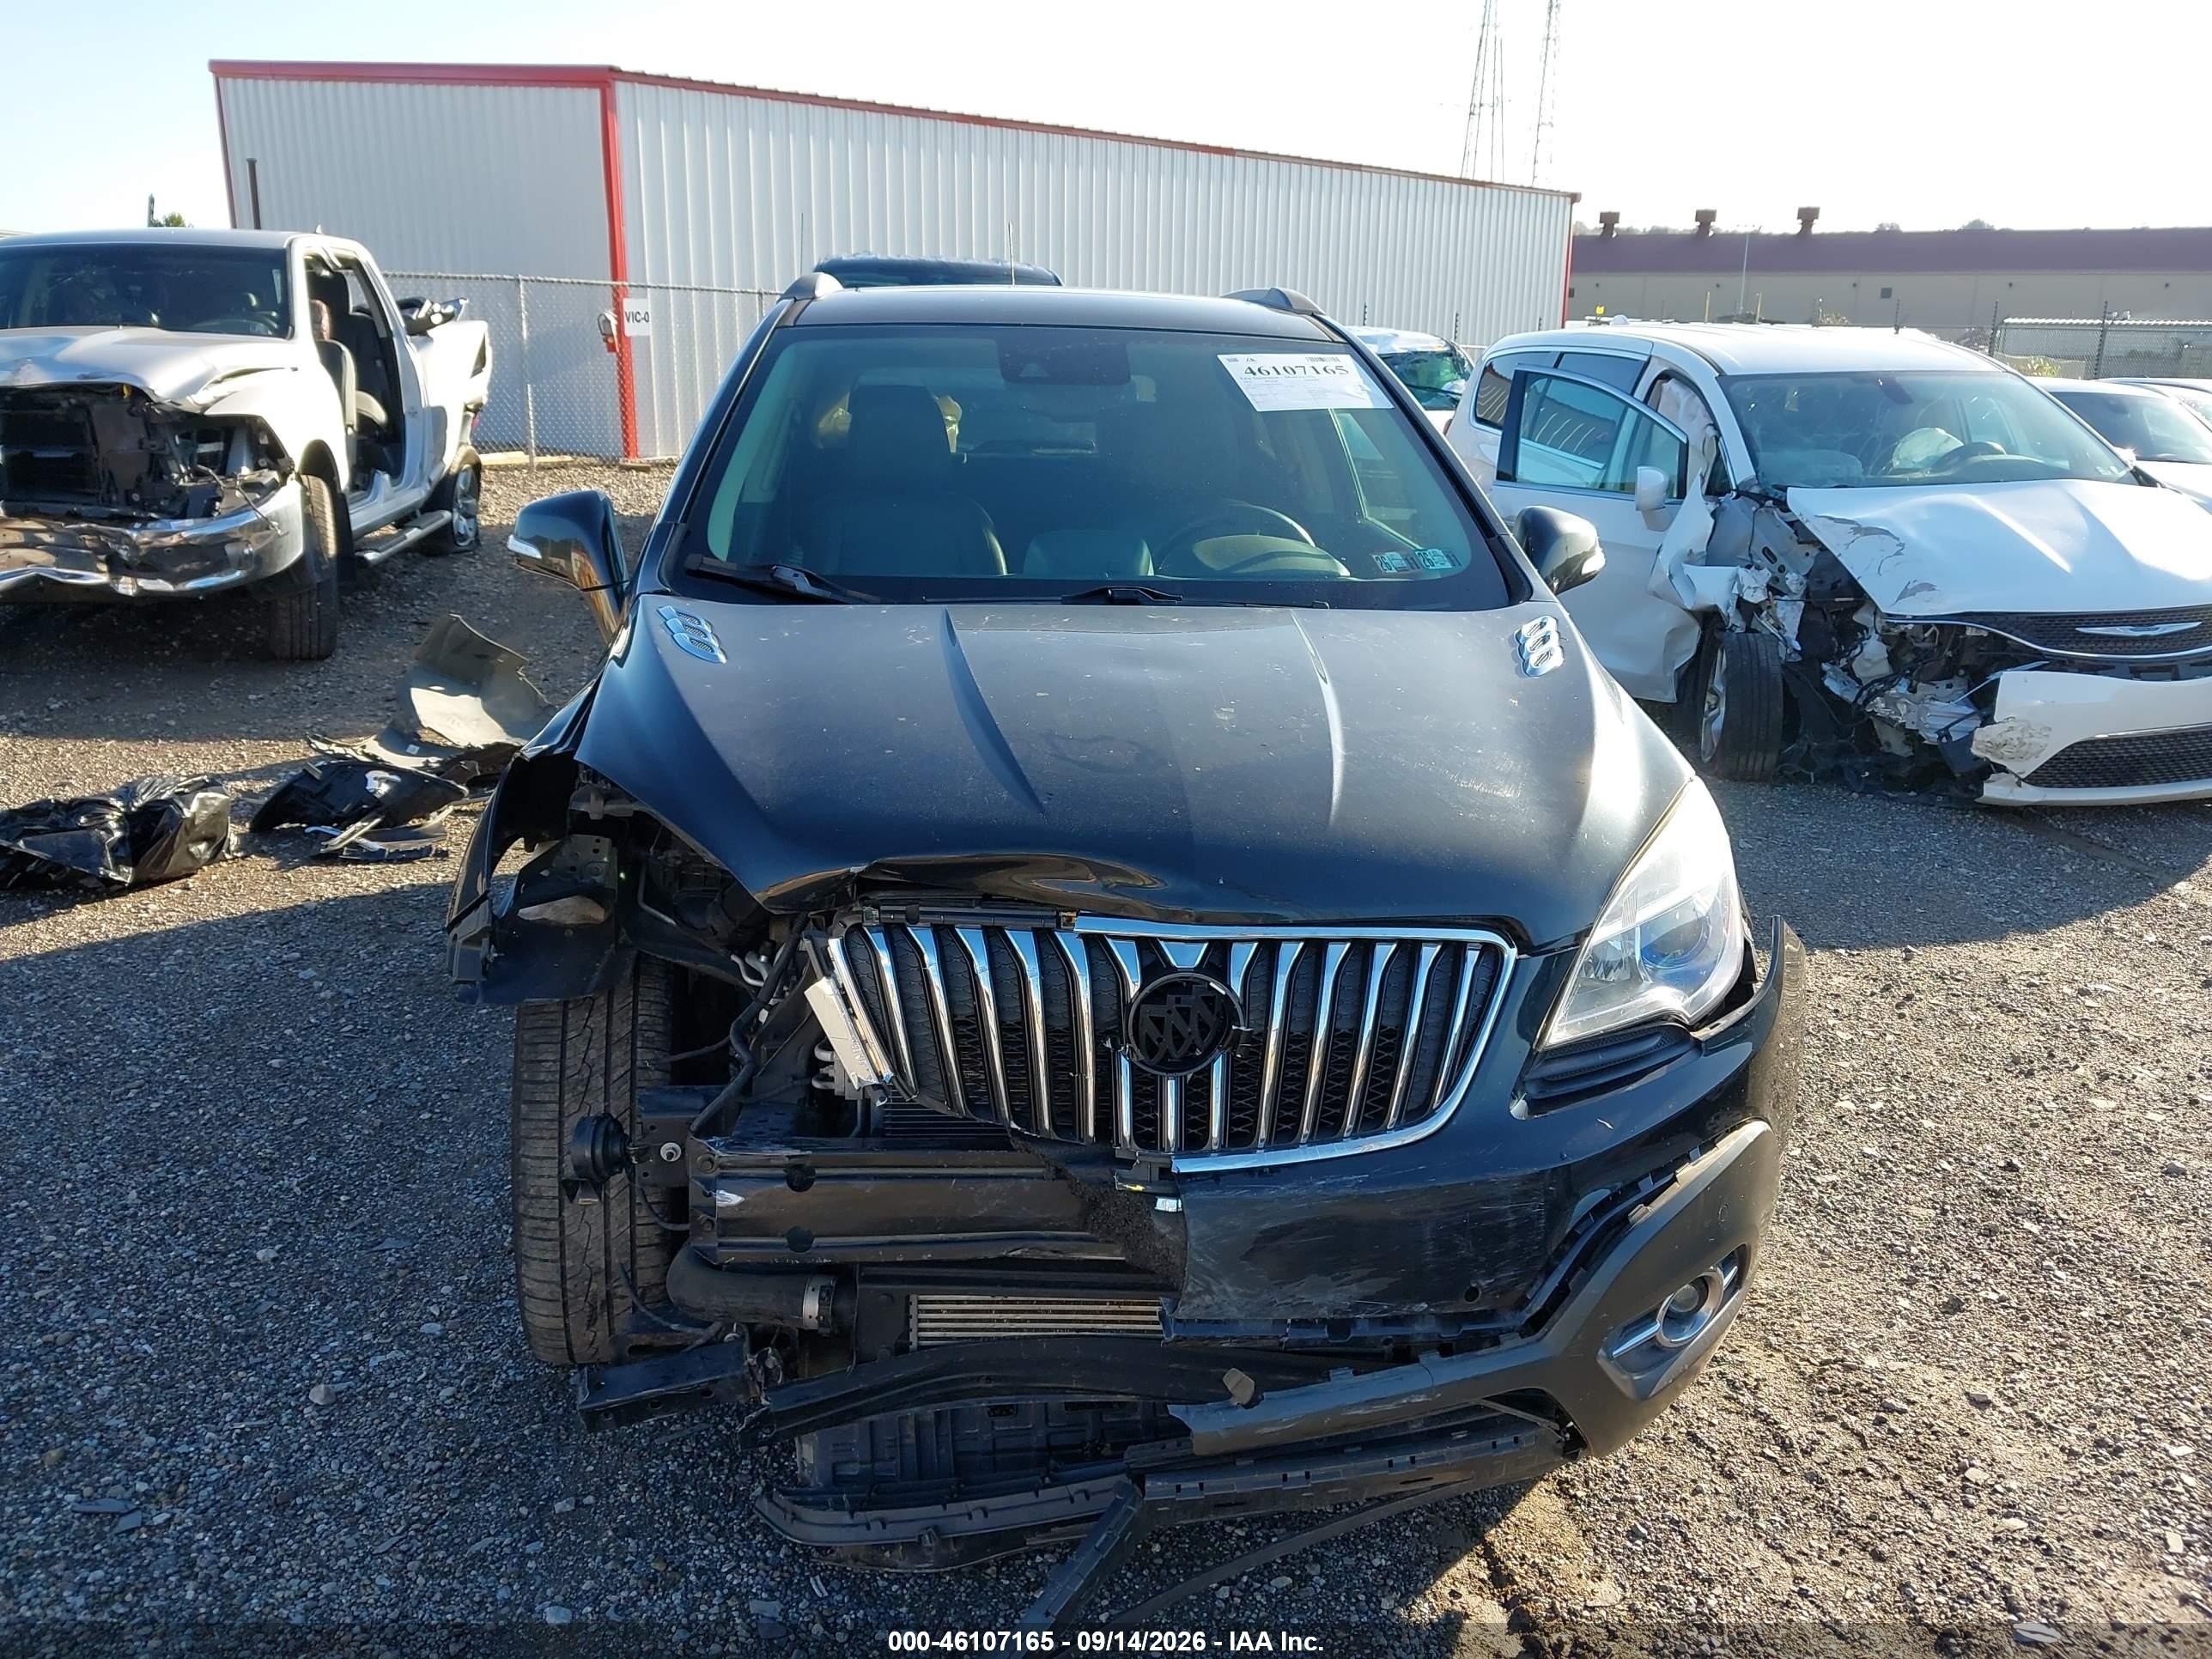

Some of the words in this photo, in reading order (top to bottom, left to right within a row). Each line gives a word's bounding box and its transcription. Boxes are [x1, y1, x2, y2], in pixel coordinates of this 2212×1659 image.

[1243, 365, 1350, 376] 46107165
[1375, 556, 1393, 571] 26
[1417, 551, 1436, 568] 26
